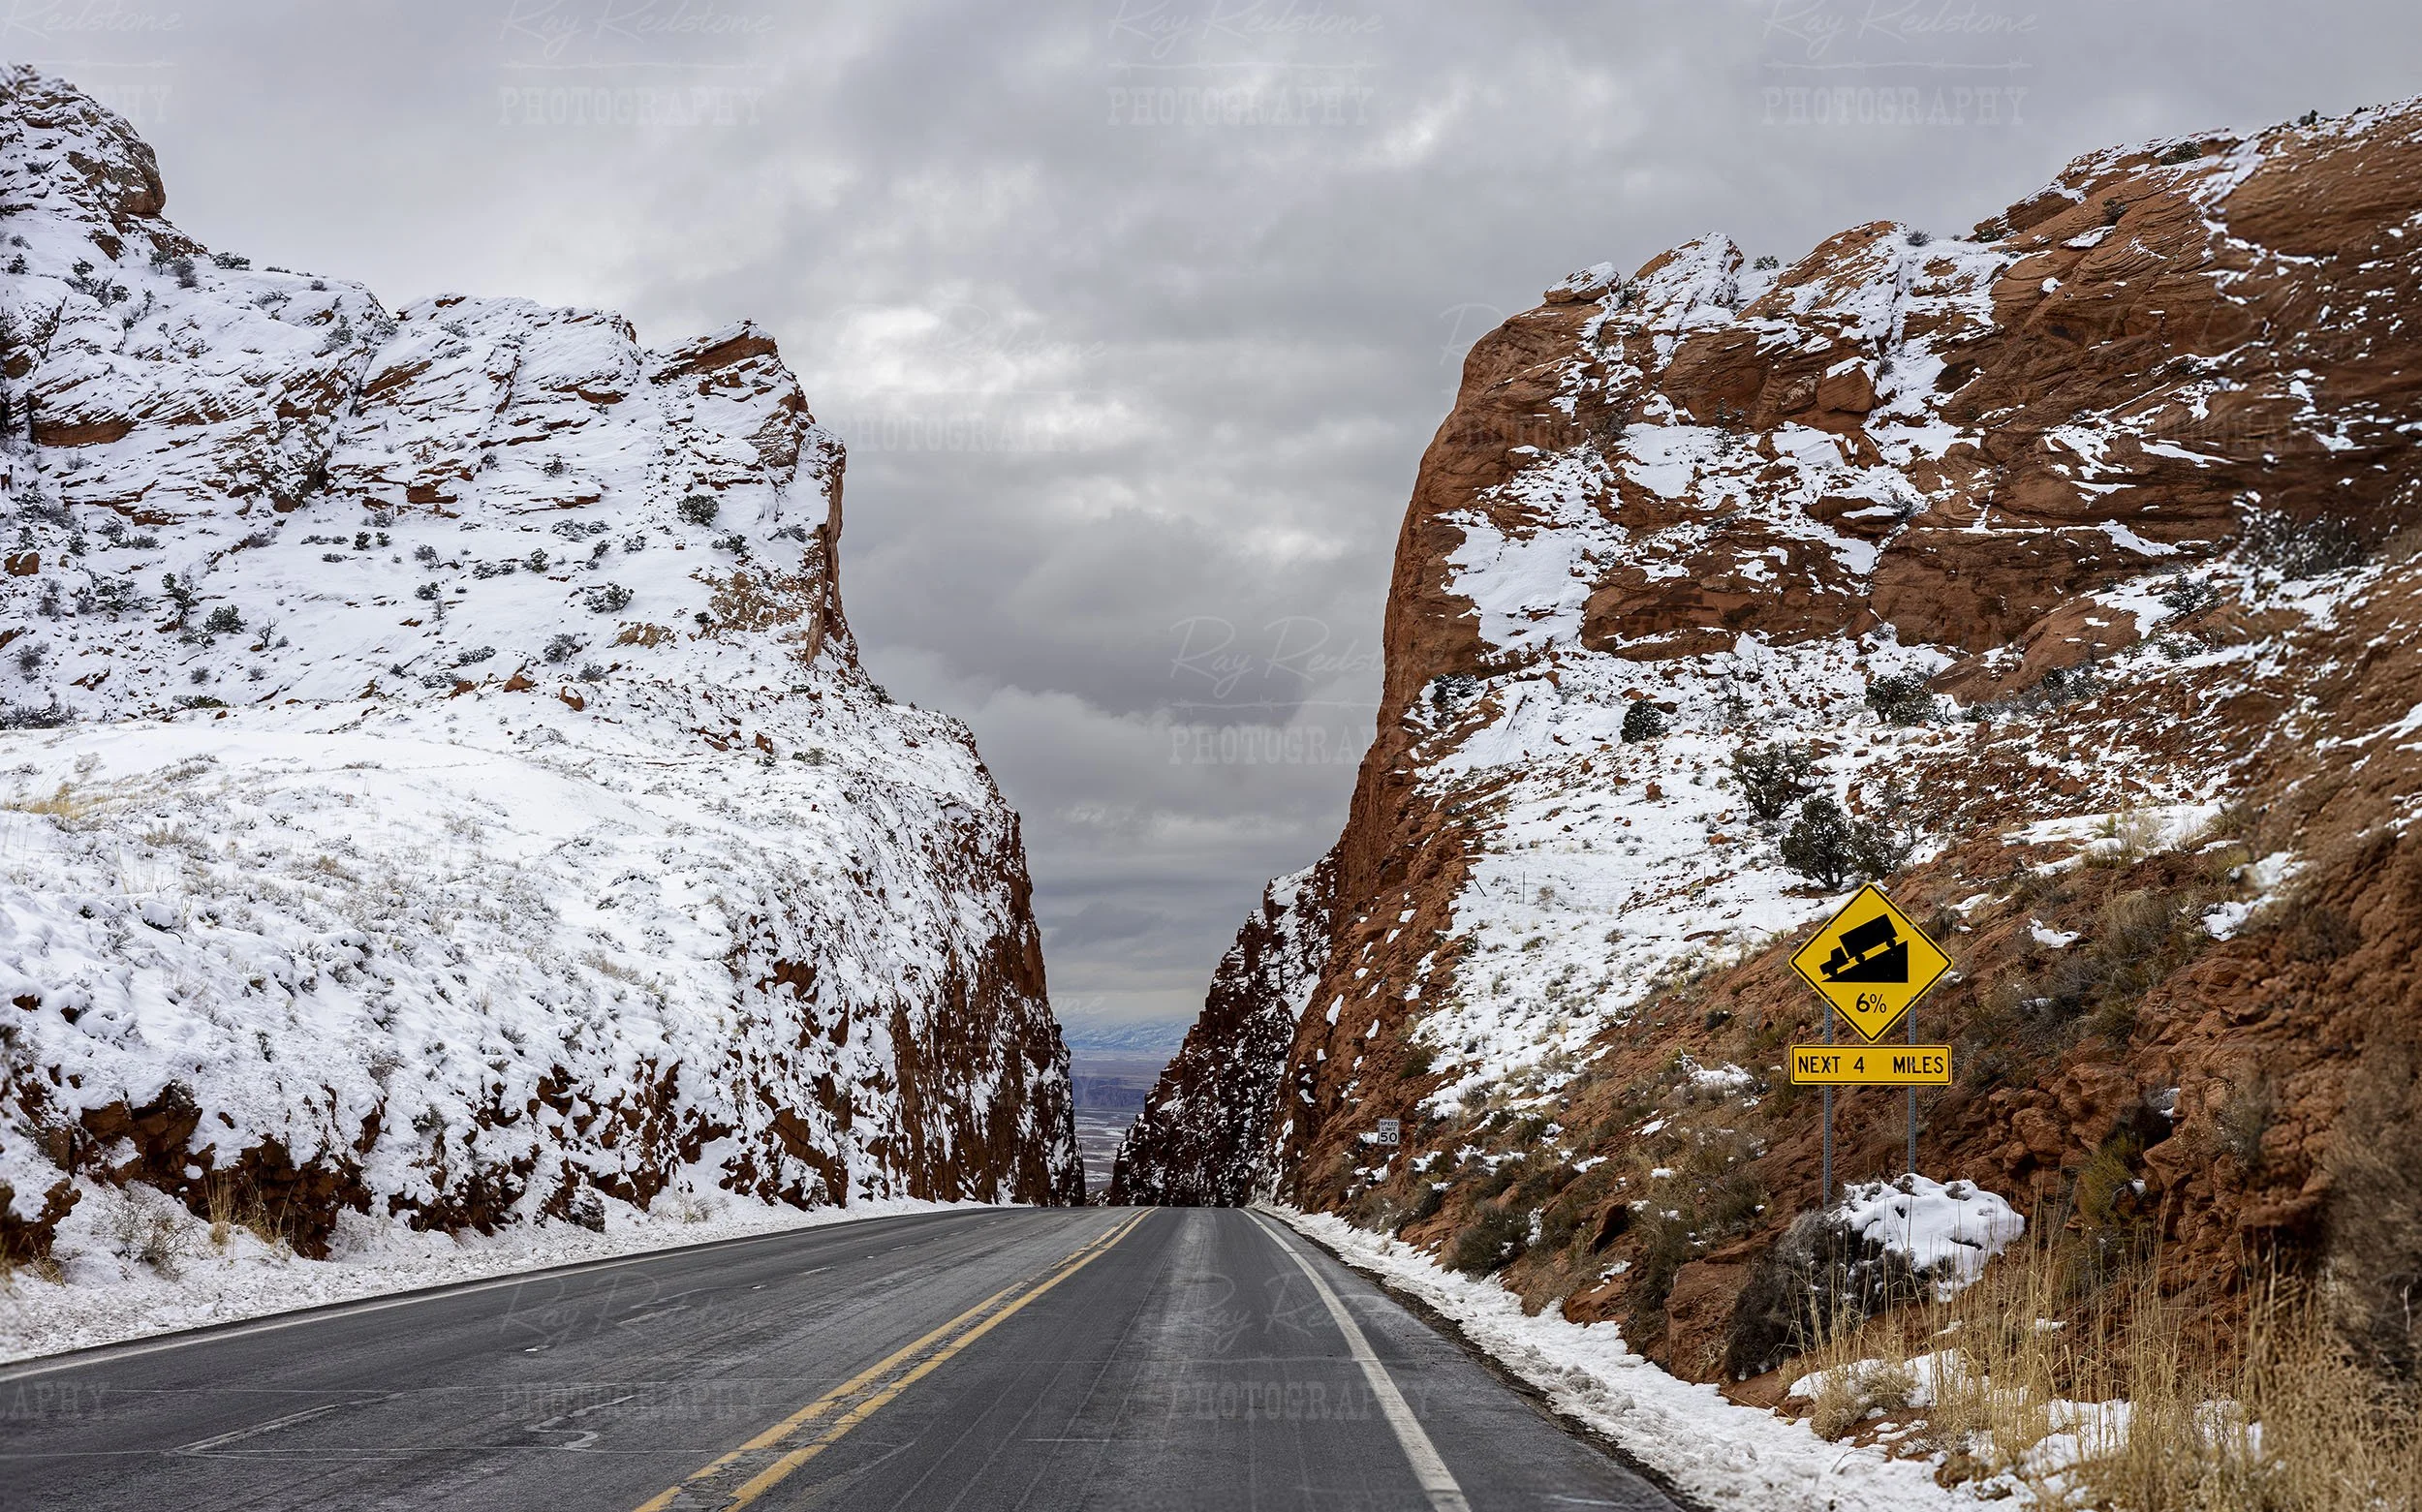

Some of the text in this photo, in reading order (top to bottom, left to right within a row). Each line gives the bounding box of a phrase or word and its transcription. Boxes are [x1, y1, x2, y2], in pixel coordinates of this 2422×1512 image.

[1855, 992, 1887, 1014] 6%
[1798, 1056, 1943, 1074] NEXT 4 MILES
[1381, 1132, 1398, 1143] 50
